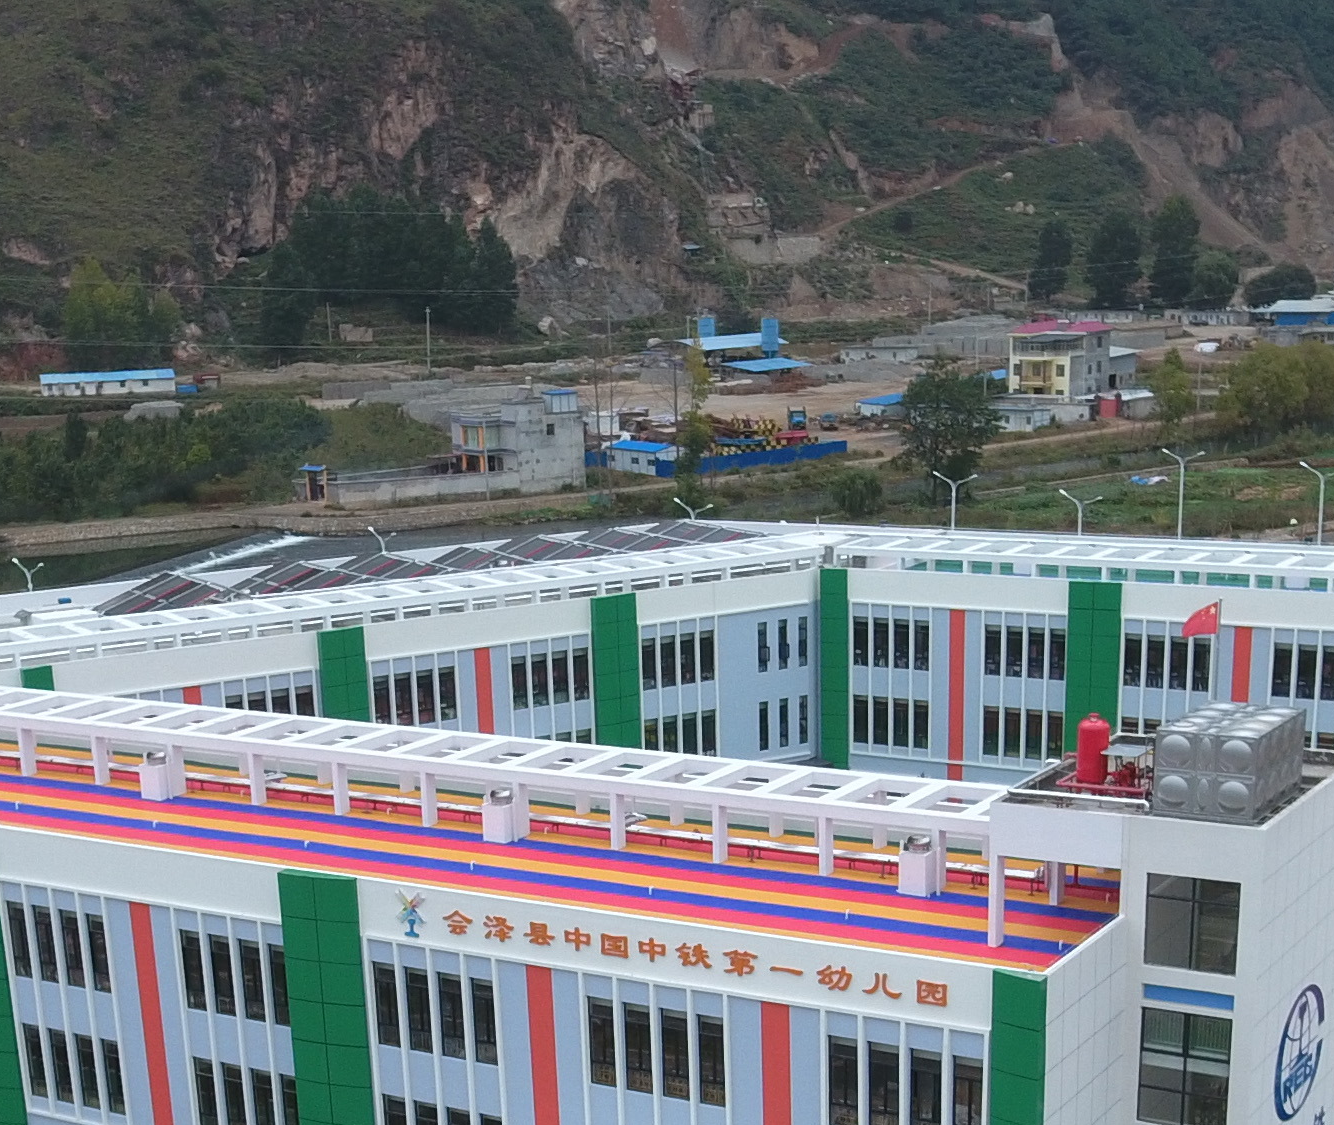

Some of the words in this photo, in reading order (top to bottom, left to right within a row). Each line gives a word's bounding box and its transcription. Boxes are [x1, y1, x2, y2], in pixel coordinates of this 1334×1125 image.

[441, 908, 949, 1007] 会泽县中国中铁第一幼儿园
